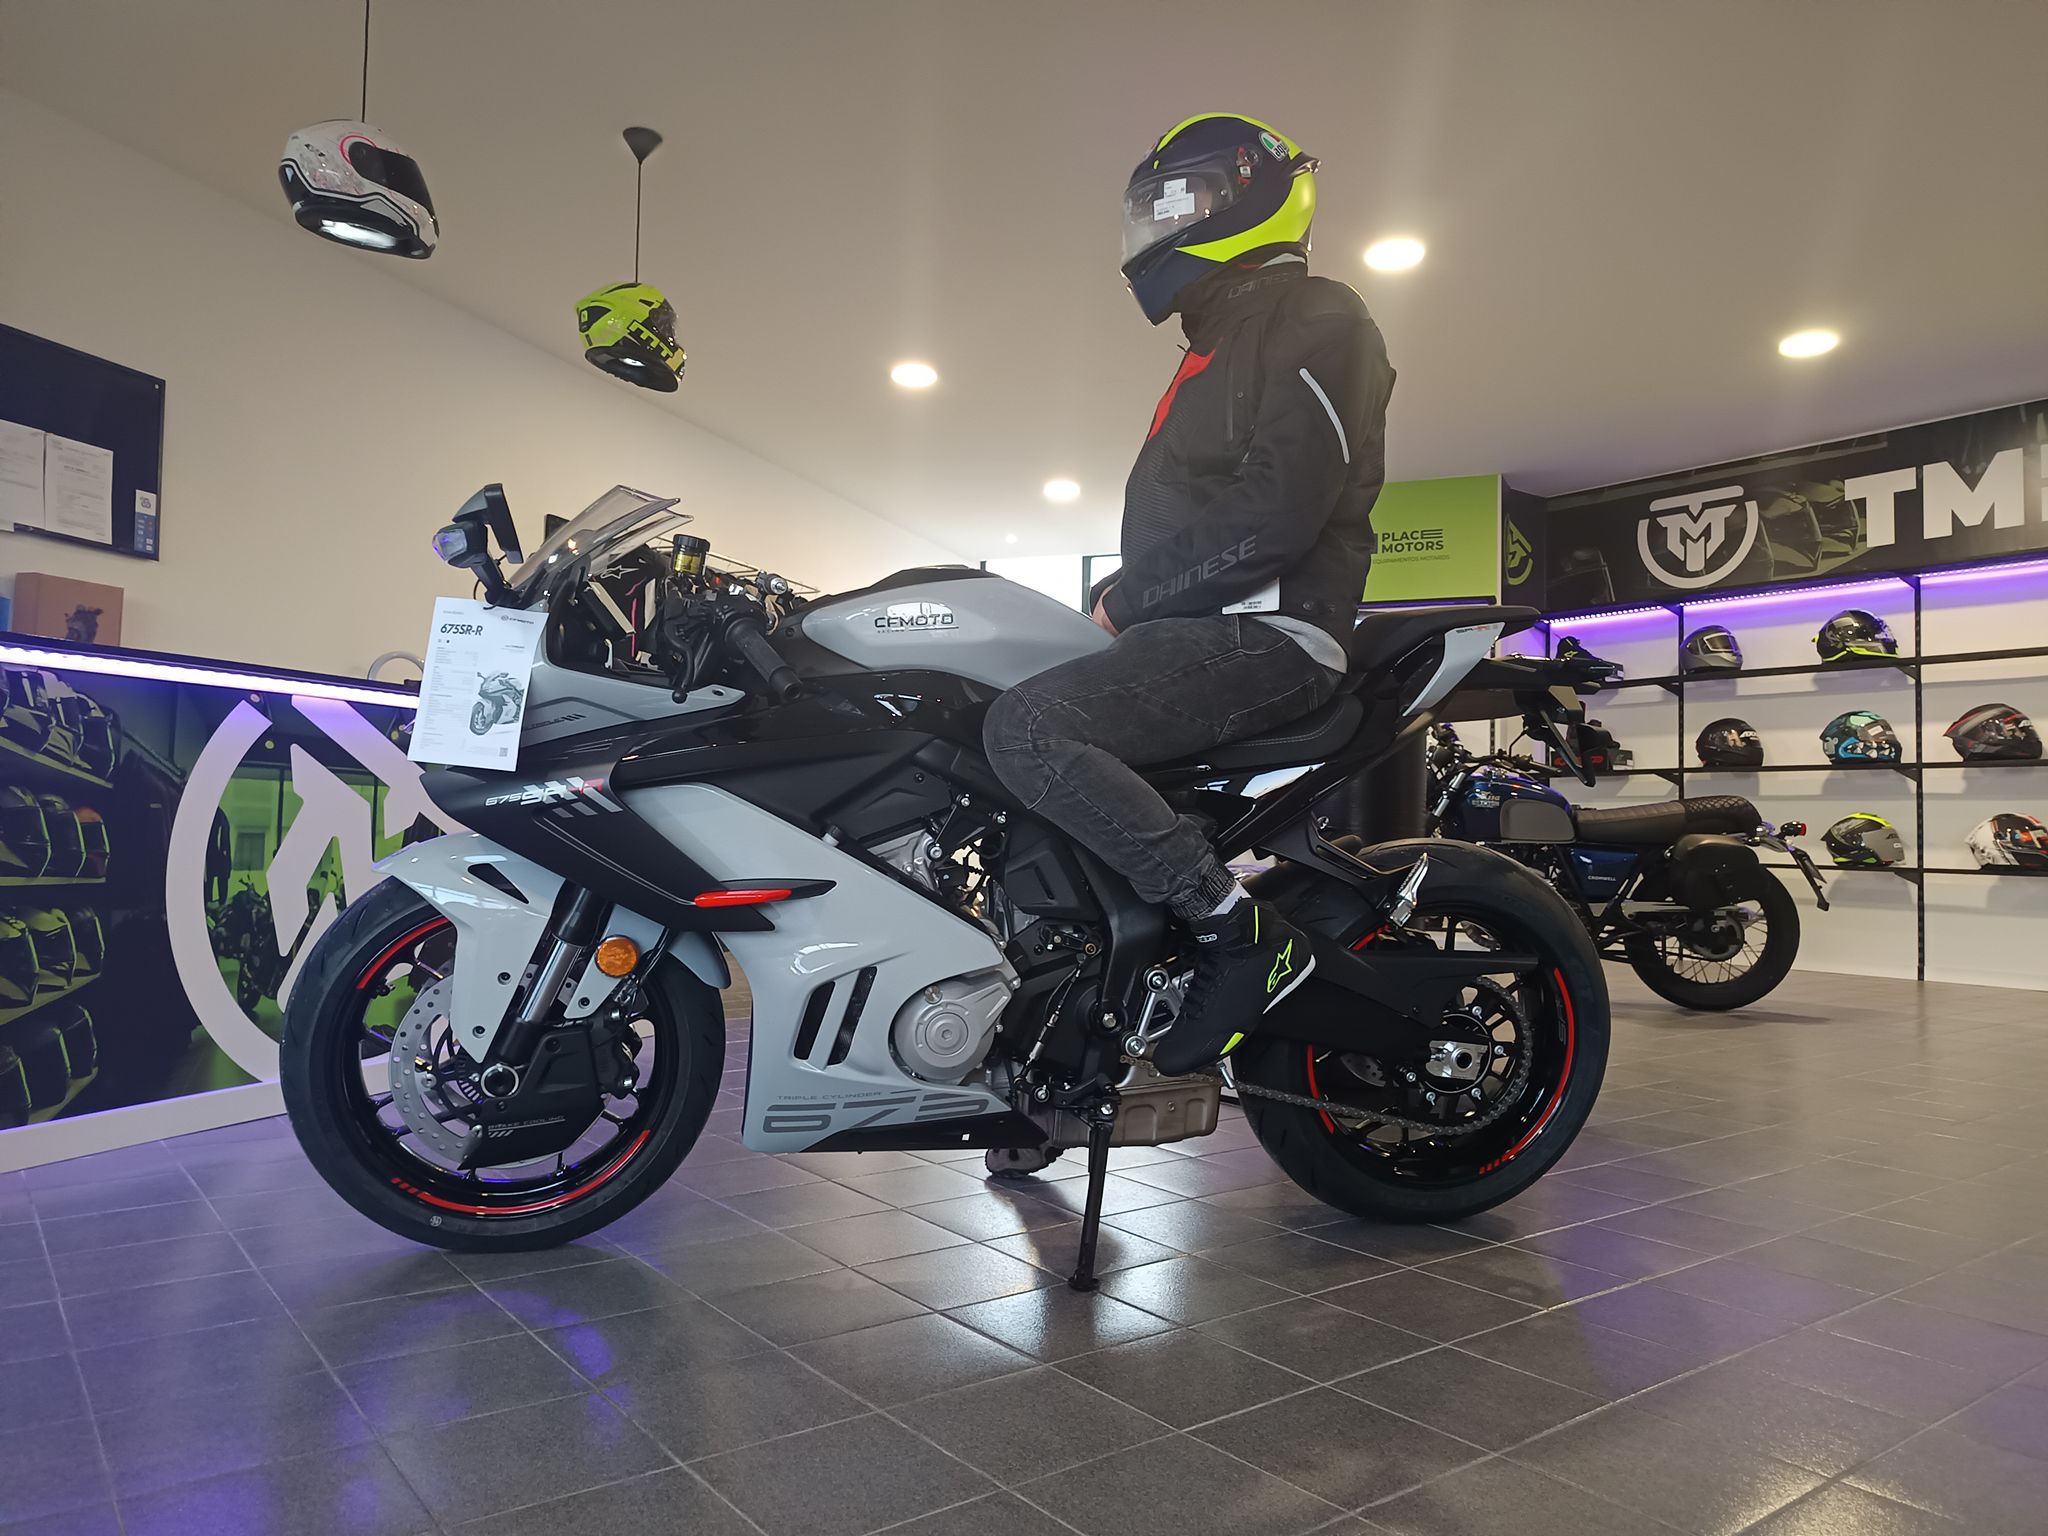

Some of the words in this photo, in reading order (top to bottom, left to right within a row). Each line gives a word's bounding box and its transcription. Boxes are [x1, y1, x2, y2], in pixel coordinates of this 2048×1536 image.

[1845, 443, 2048, 548] TM
[1381, 529, 1443, 542] PLACE
[1381, 540, 1444, 554] MOTORS
[1142, 535, 1257, 609] DAINESE
[874, 613, 954, 628] CFMOTO
[440, 623, 484, 636] 675SR-R
[822, 1091, 882, 1100] CYLINDER
[762, 1092, 990, 1134] 675
